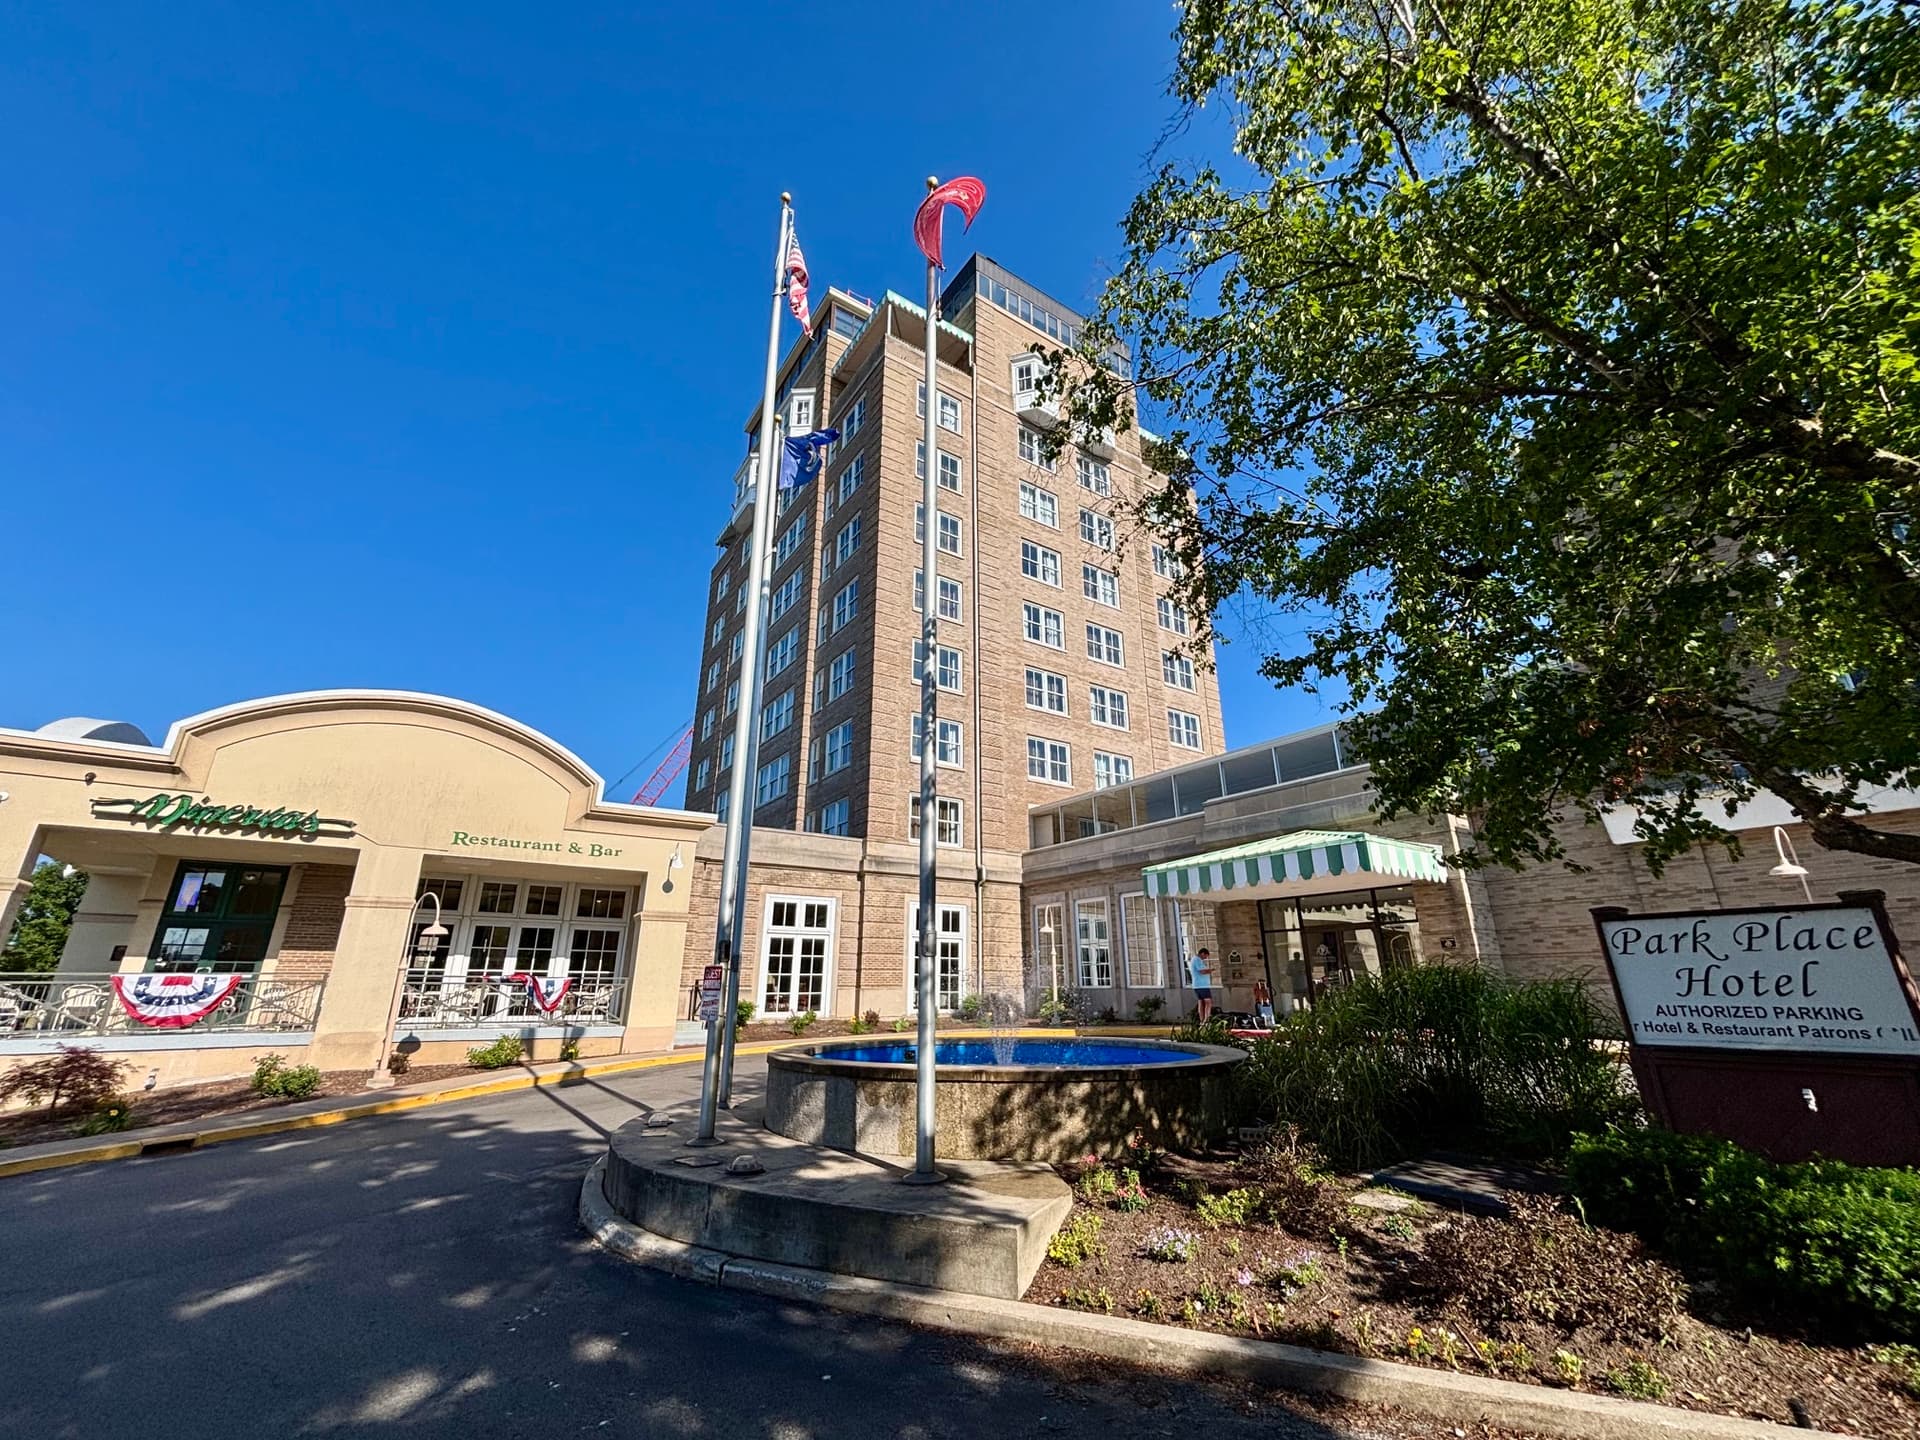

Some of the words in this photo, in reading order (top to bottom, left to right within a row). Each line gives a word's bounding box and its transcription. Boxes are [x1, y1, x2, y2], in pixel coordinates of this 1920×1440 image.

[452, 831, 562, 852] Restaurant
[568, 841, 583, 854] &
[589, 843, 623, 857] Bar
[1611, 919, 1729, 961] Park
[1733, 915, 1875, 951] Place
[1675, 960, 1820, 998] Hotel
[1656, 1004, 1768, 1020] AUTHORIZED
[1772, 1006, 1864, 1021] PARKING
[1643, 1021, 1682, 1034] Hotel
[1687, 1022, 1699, 1035] &
[1703, 1022, 1794, 1038] Restaurant
[1799, 1025, 1872, 1040] Patrons
